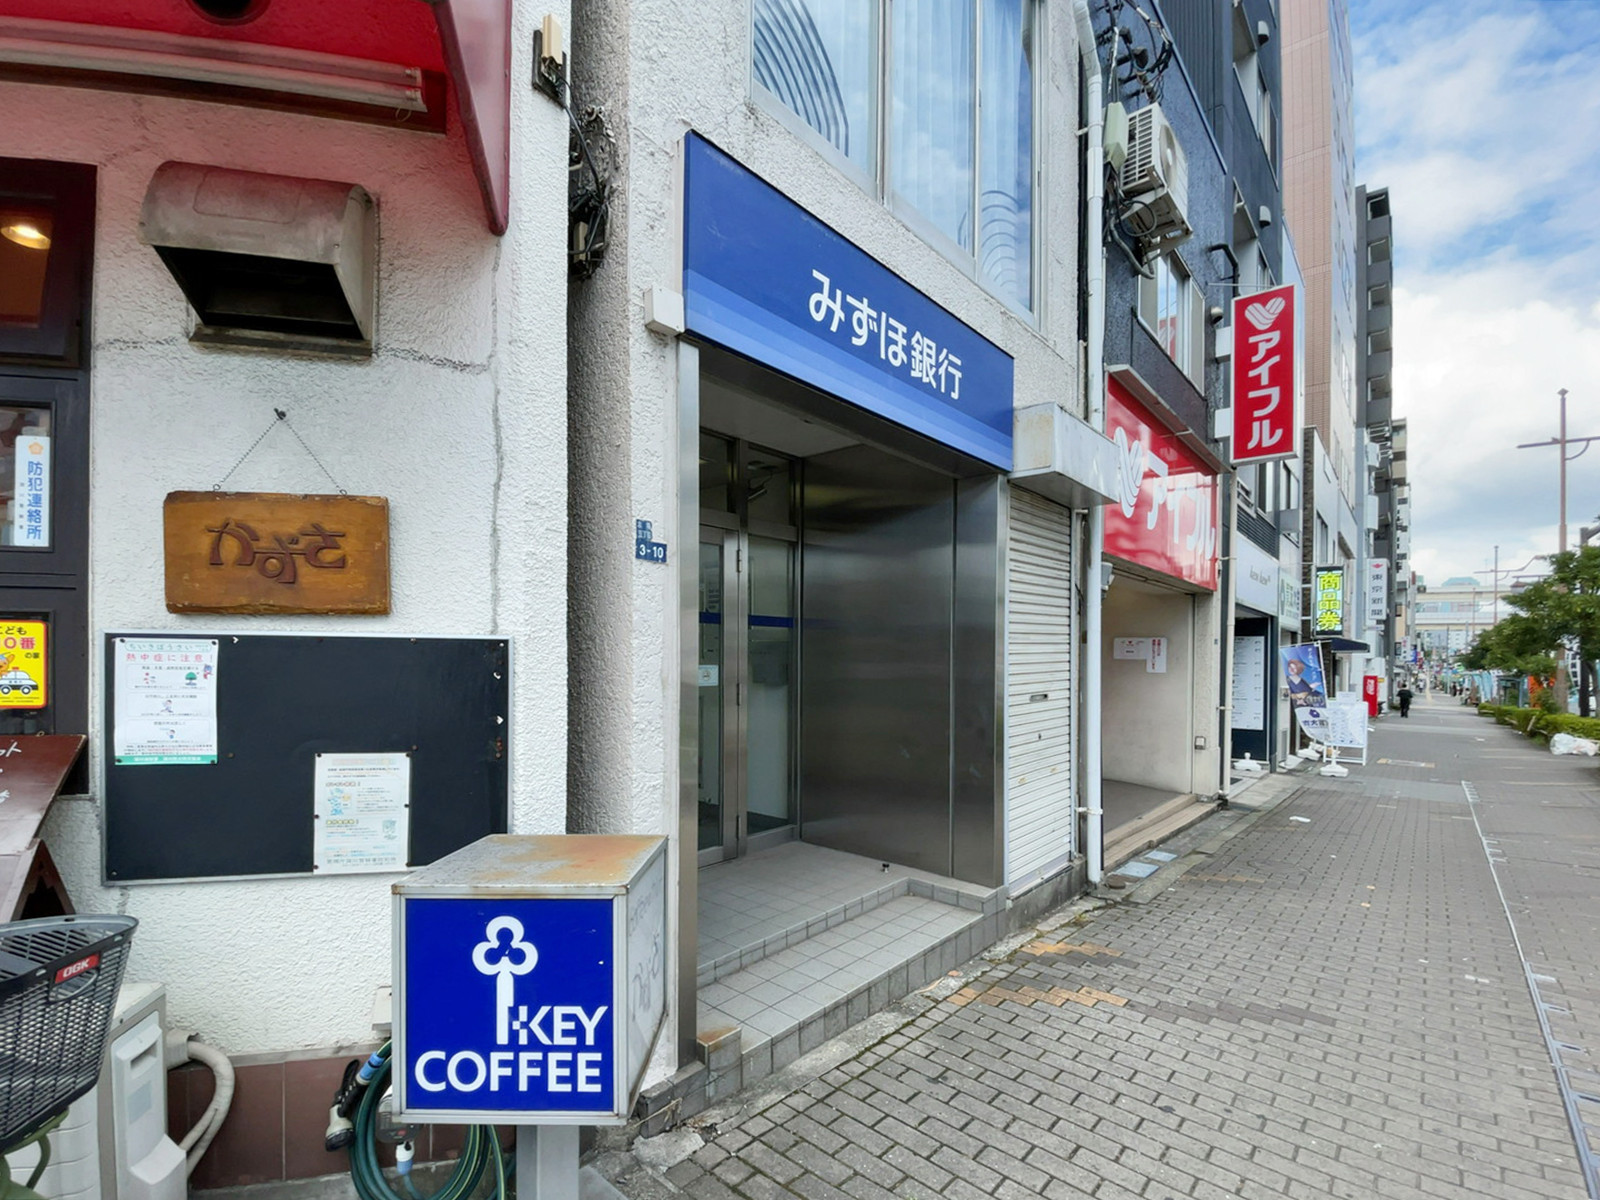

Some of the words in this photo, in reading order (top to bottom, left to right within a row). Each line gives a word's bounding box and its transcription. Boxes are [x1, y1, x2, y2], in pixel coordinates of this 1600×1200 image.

[809, 269, 962, 400] みずほ銀行
[1248, 330, 1284, 450] アイフル
[27, 461, 43, 540] 防犯連絡所
[1147, 450, 1215, 561] アイフル
[206, 519, 346, 584] かずさ
[639, 544, 664, 559] 3-10
[1317, 572, 1341, 631] 商品券
[63, 958, 90, 977] OGK
[512, 1006, 609, 1045] KEY
[414, 1050, 602, 1092] COFFEE
